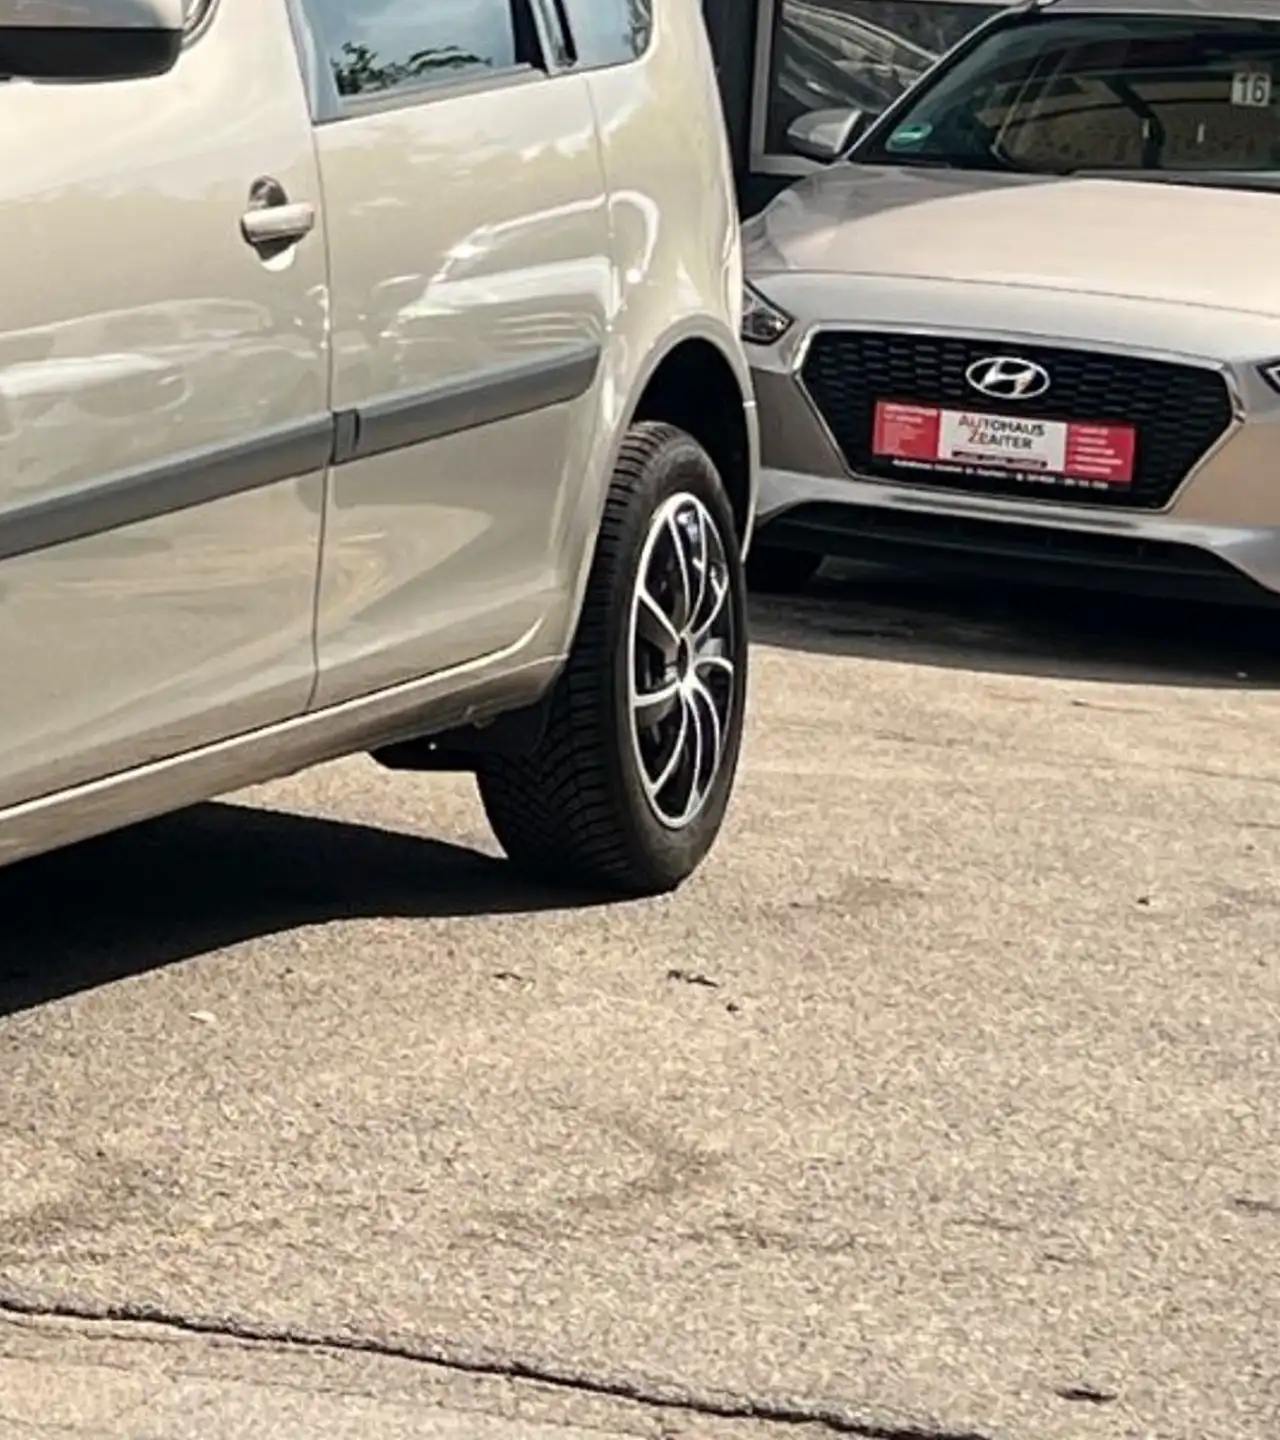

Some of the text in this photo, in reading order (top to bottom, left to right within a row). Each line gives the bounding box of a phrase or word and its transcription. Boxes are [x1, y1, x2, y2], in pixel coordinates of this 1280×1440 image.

[1239, 74, 1266, 104] 16
[958, 414, 1045, 437] AUTOHAUS
[968, 429, 1033, 450] ZEAITER
